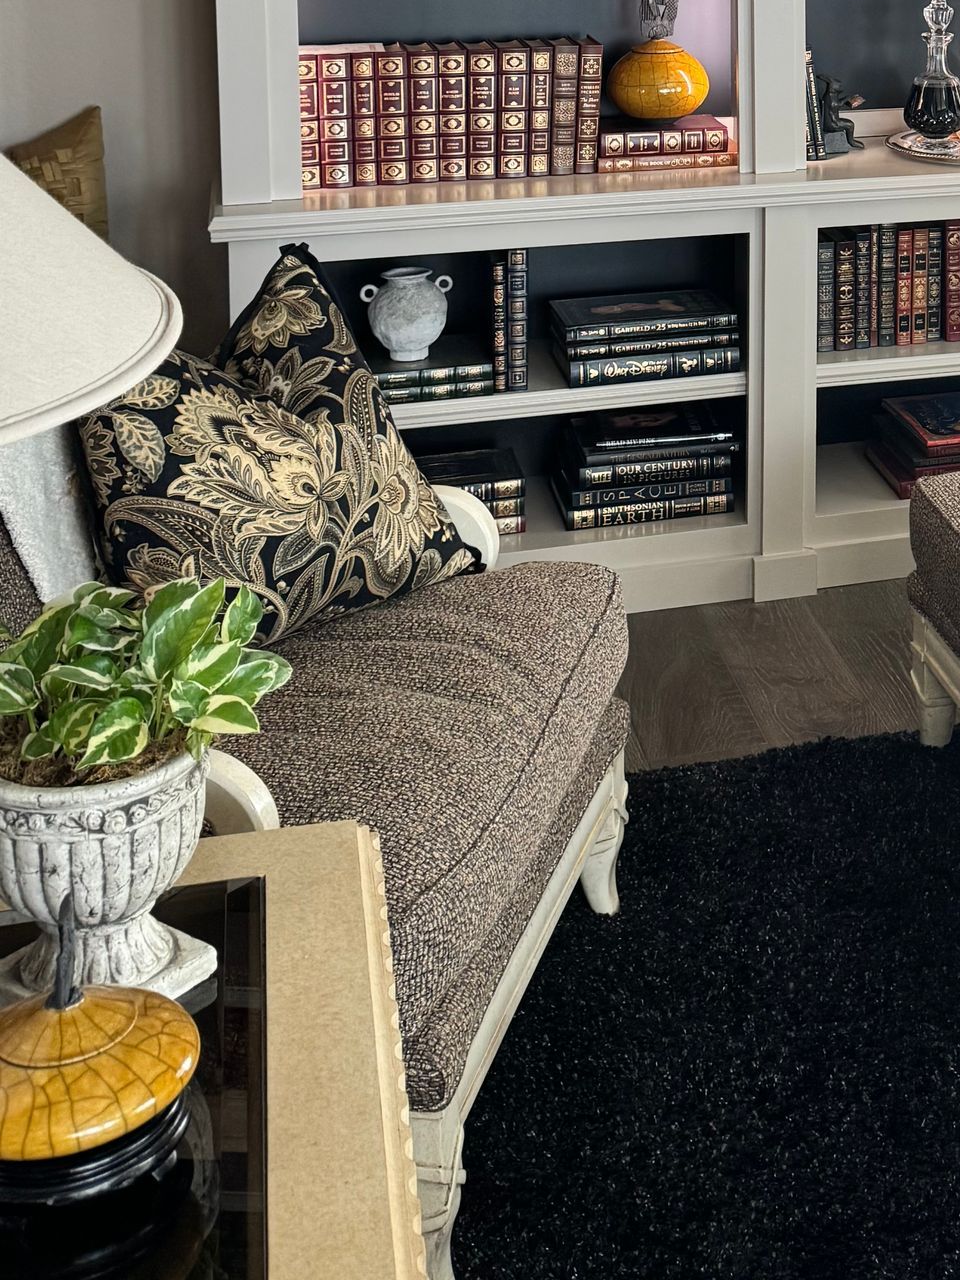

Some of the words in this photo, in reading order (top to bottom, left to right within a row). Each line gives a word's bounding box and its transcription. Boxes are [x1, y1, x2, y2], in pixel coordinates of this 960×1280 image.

[615, 324, 650, 335] GARFIELD
[656, 323, 667, 332] 25
[616, 343, 651, 354] GARFIELD
[656, 341, 667, 351] 25
[604, 362, 630, 378] WALT
[626, 360, 668, 377] DISNEY
[618, 464, 642, 475] OUR
[643, 459, 695, 472] CENTURY
[591, 471, 612, 483] LIFE
[623, 475, 632, 484] IN
[639, 469, 691, 483] PICTURES
[602, 501, 664, 515] SMITHSONIAN
[602, 509, 665, 527] EARTH
